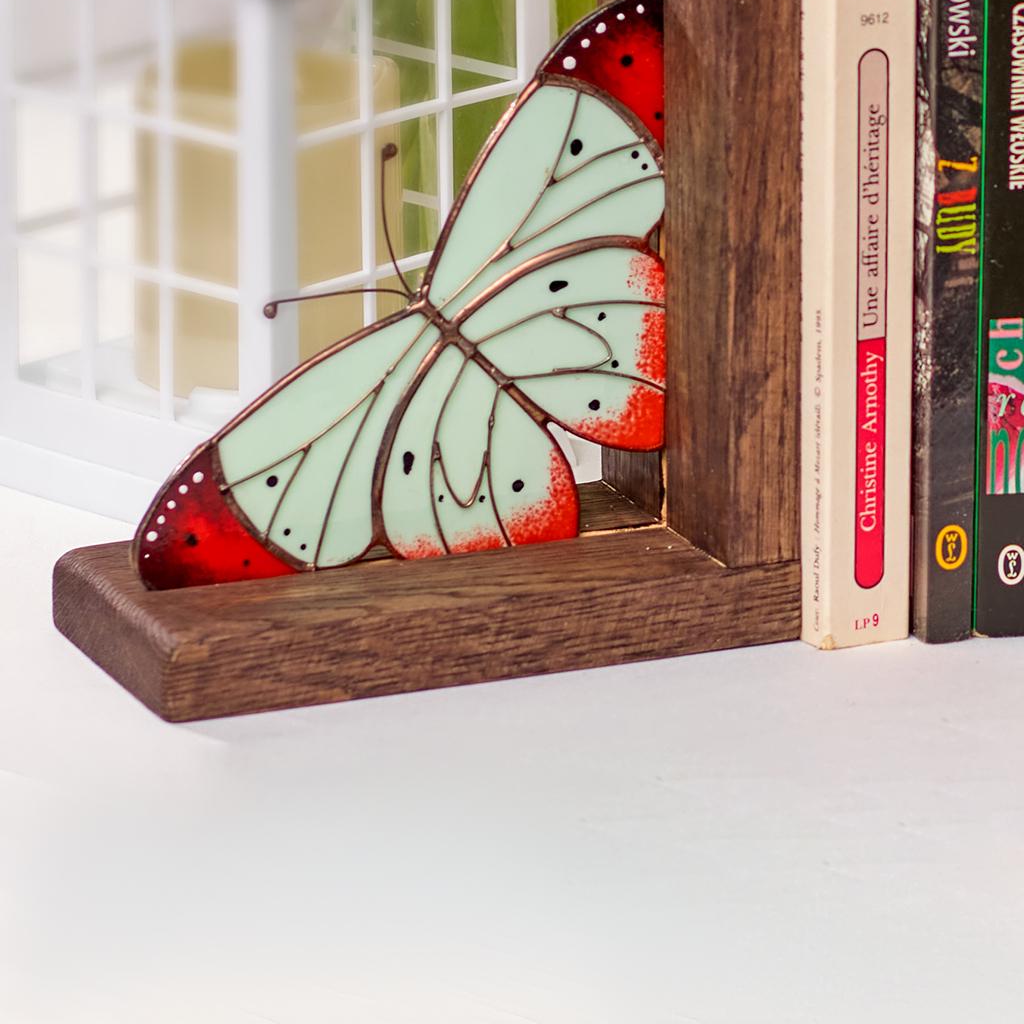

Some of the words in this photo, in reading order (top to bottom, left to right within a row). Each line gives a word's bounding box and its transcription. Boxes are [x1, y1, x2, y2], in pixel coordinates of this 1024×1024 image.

[860, 11, 890, 26] 9612
[862, 102, 888, 206] d'héritage
[860, 213, 881, 278] affaire
[863, 286, 880, 329] Une
[860, 350, 885, 434] Arnothy
[859, 441, 878, 533] Christine
[854, 618, 871, 632] LP
